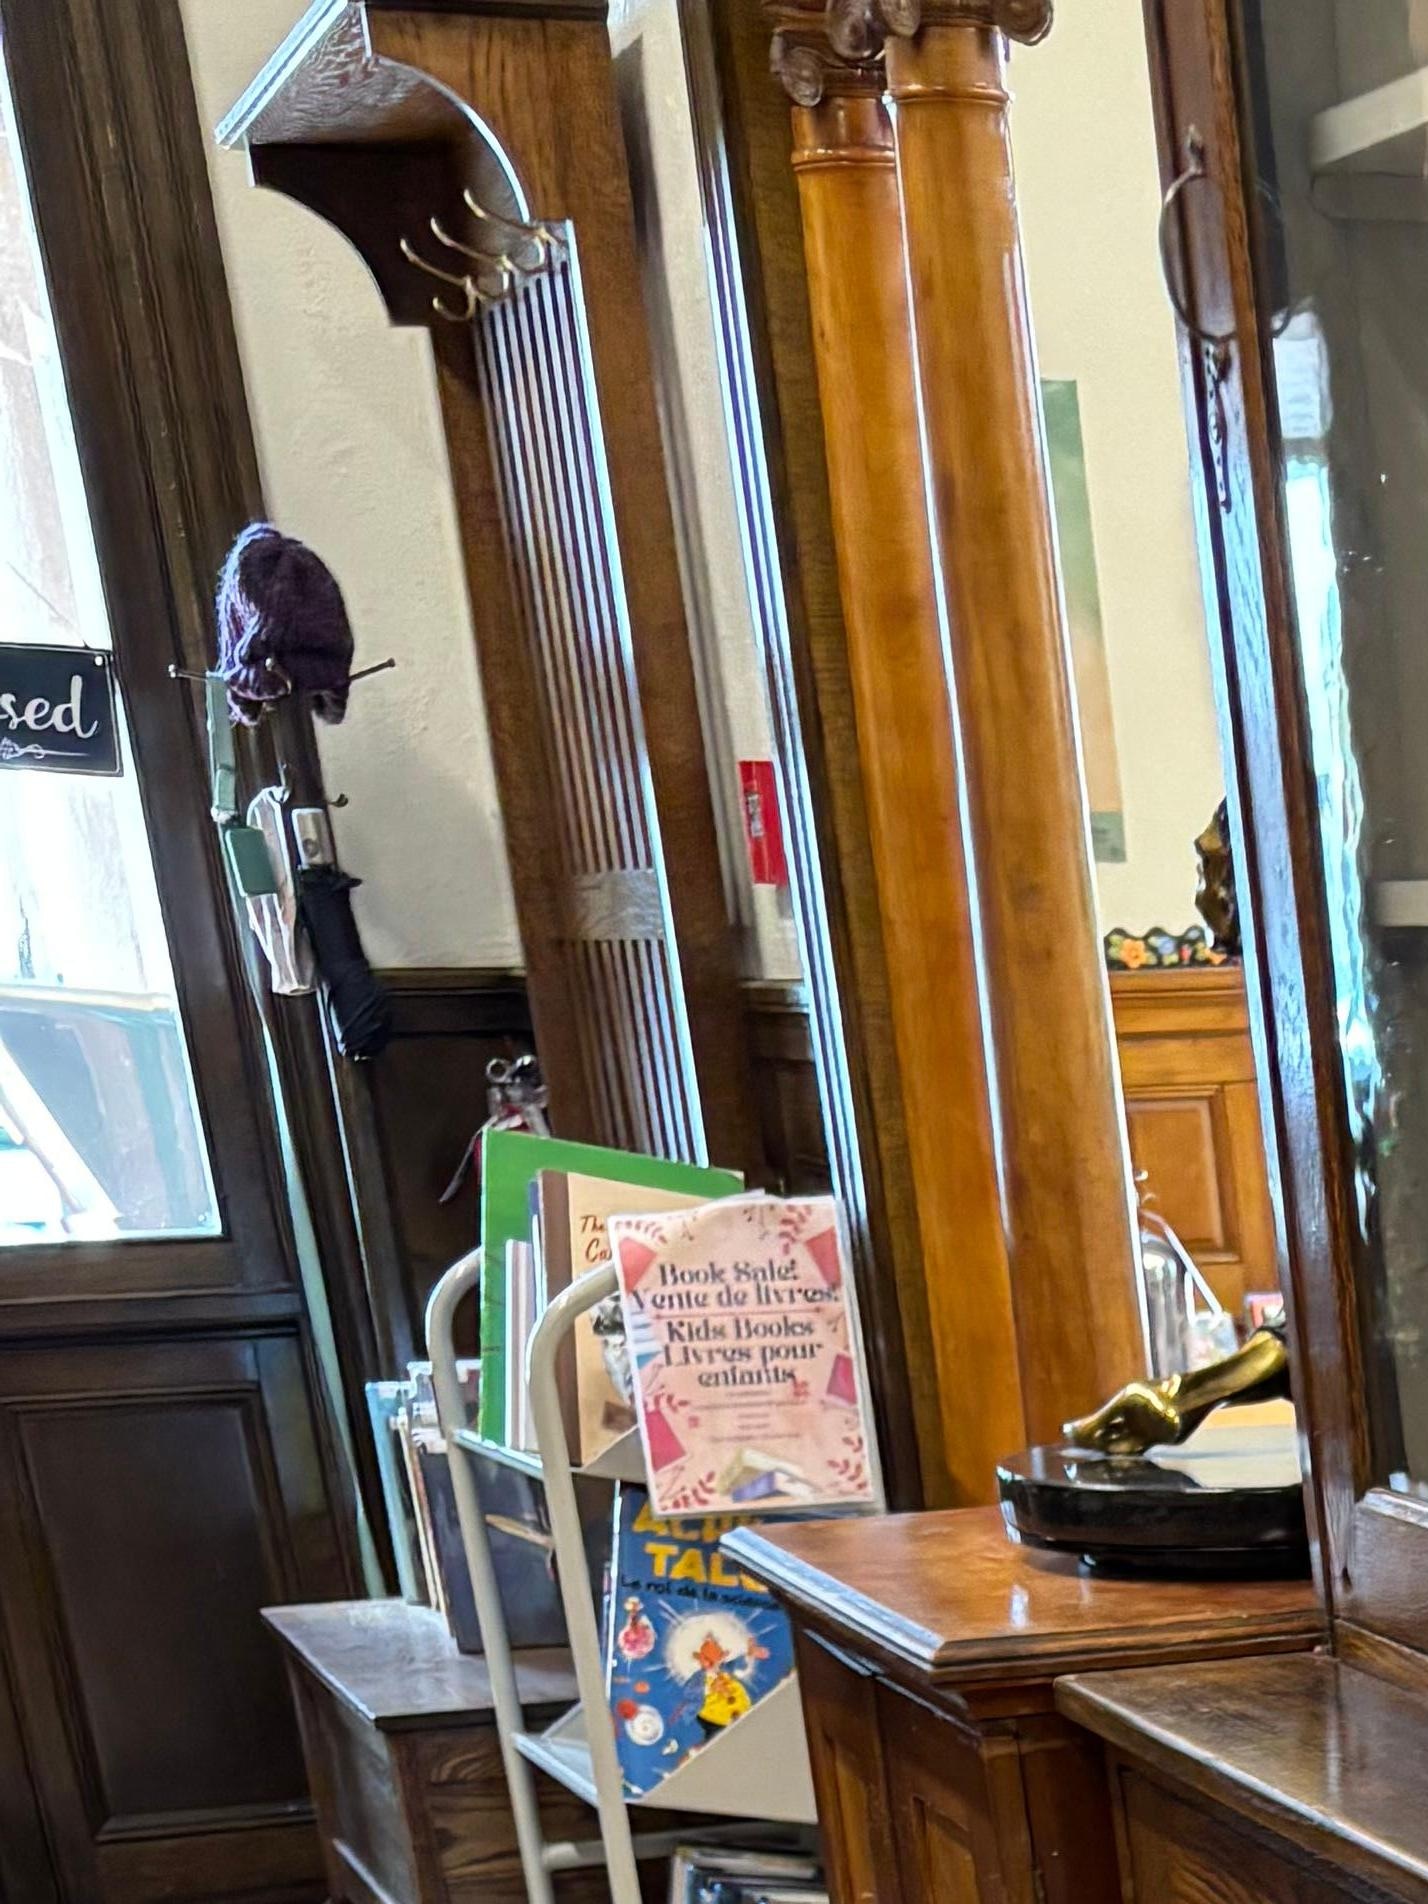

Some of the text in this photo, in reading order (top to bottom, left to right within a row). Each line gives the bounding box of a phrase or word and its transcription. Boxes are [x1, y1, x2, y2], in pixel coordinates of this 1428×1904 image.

[0, 674, 99, 739] sed
[659, 1258, 799, 1287] Book Sale!
[631, 1282, 840, 1311] Vente de livres!
[667, 1315, 815, 1343] Kids Books
[664, 1342, 824, 1368] Livres pour
[697, 1365, 797, 1388] enfants
